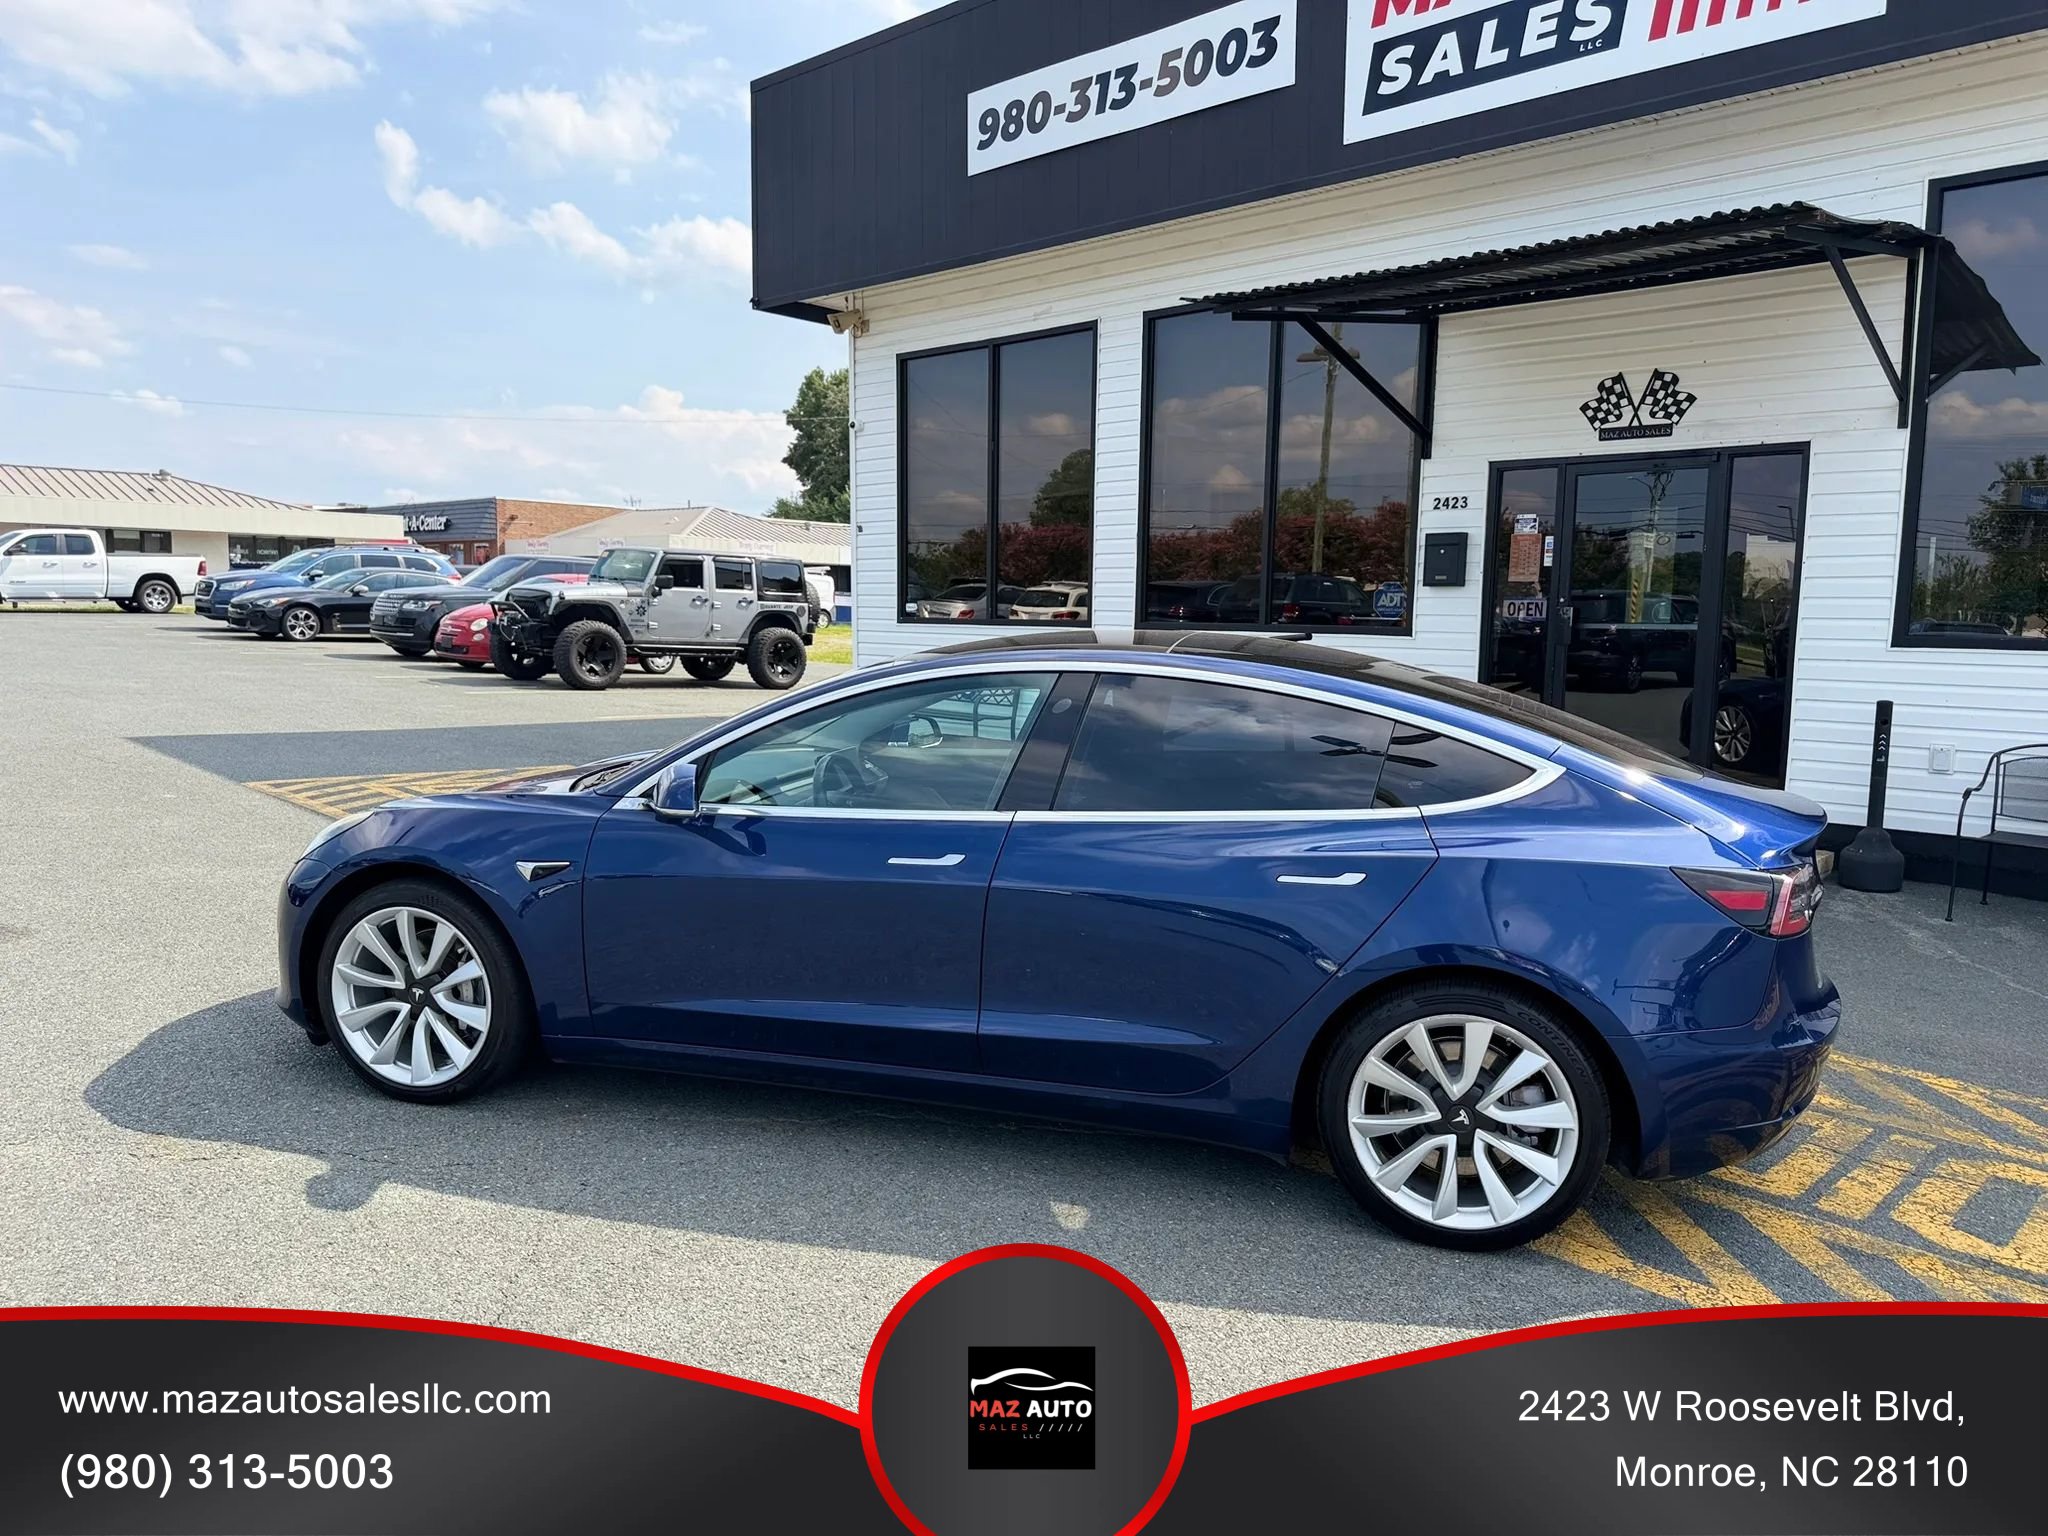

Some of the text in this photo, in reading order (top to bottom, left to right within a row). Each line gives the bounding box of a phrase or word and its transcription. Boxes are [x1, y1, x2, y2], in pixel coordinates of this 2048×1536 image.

[1377, 0, 1612, 95] SALES
[1579, 39, 1603, 52] LLC
[976, 15, 1281, 151] 980-313-5003
[1600, 427, 1671, 439] MAZ AUTO SALES
[1433, 496, 1468, 510] 2423
[1377, 592, 1404, 607] ADT
[1507, 601, 1544, 617] OPEN
